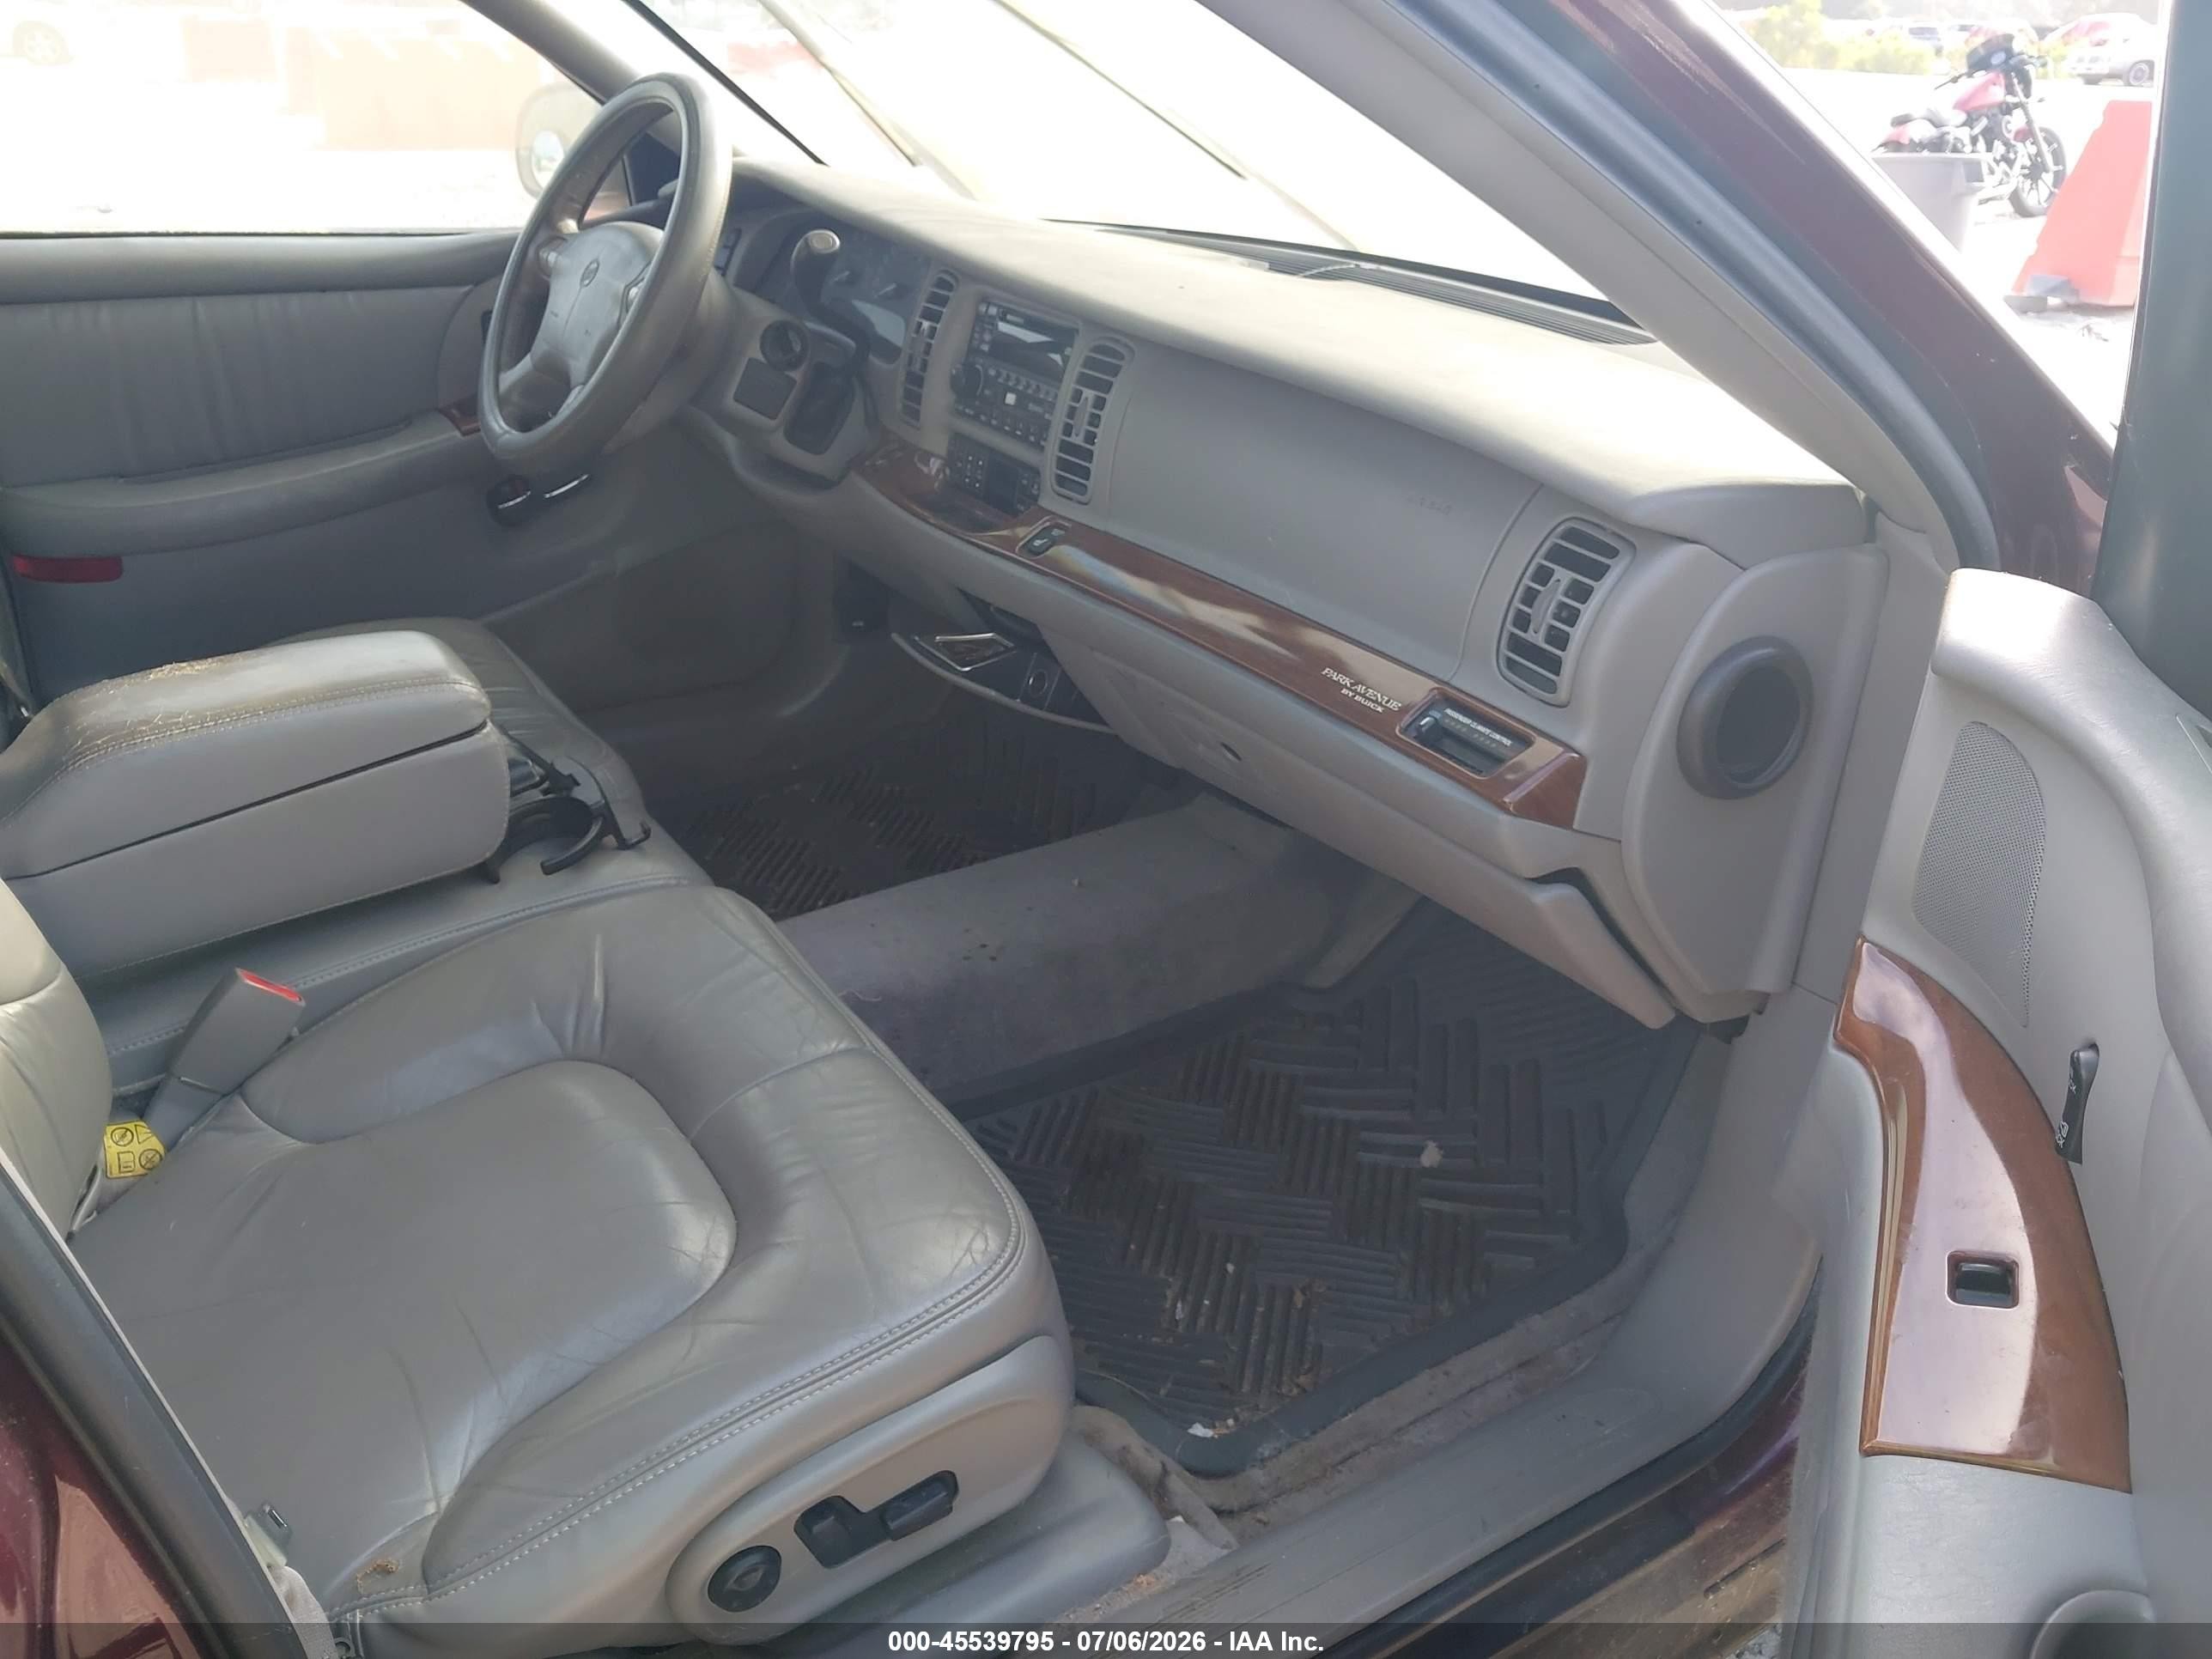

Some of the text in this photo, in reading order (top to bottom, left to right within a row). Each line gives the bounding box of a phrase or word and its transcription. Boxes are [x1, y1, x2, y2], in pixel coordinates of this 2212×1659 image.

[1321, 667, 1402, 711] PARK AVENUE
[1340, 688, 1385, 714] BY BUICK
